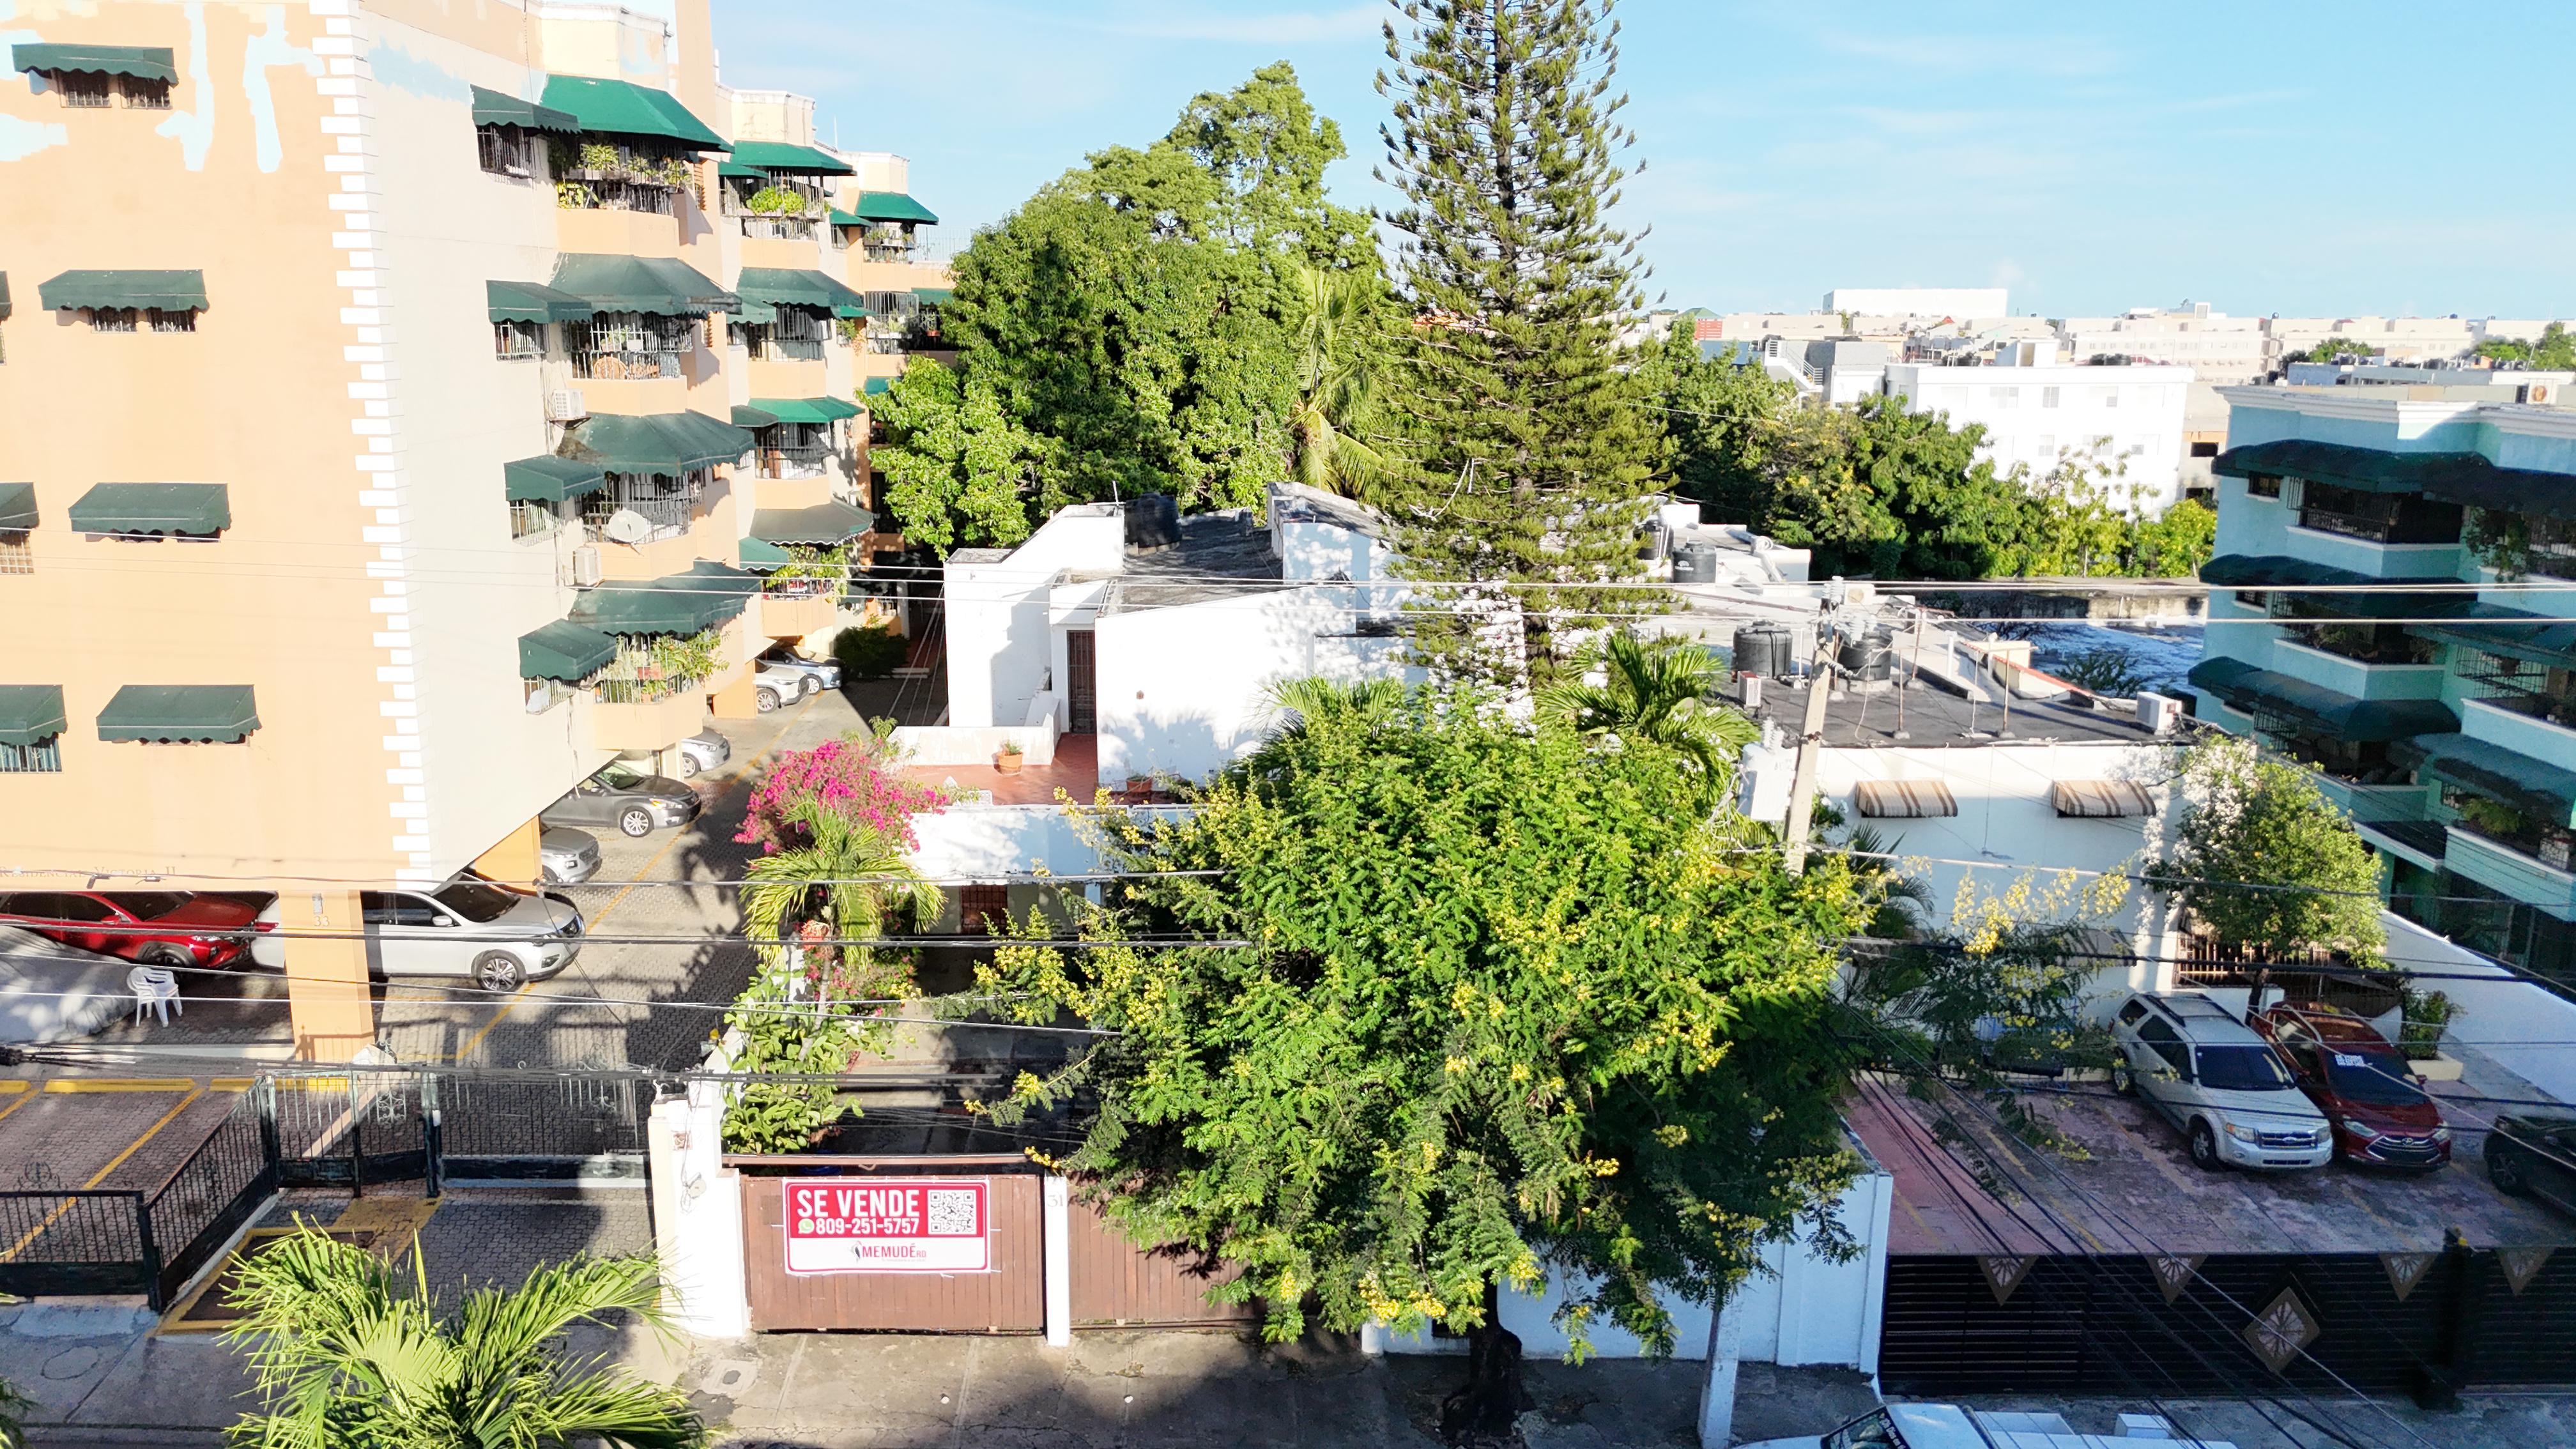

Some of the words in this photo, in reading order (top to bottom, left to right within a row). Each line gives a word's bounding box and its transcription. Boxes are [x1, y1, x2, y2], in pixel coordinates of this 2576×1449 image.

[313, 916, 330, 926] 33
[797, 1190, 829, 1217] SE
[836, 1190, 920, 1217] VENDE
[1047, 1194, 1064, 1207] 31
[815, 1218, 920, 1234] 809-251-5757
